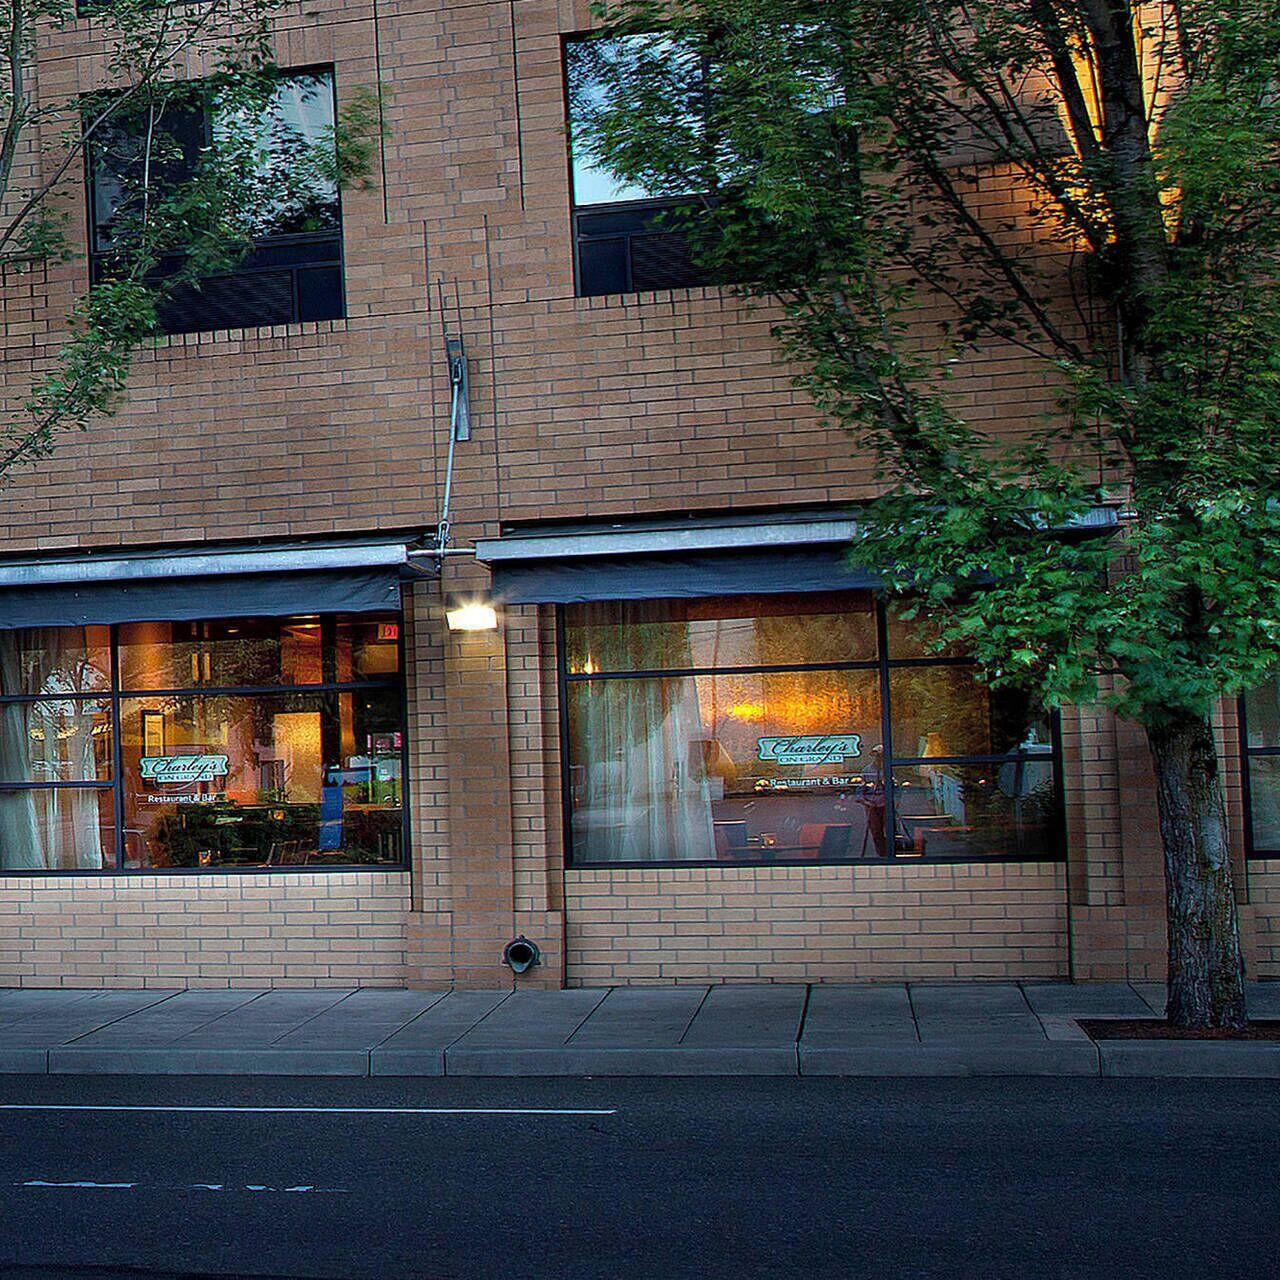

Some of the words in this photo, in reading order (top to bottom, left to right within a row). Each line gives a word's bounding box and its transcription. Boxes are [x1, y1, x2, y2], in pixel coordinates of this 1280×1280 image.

[771, 736, 848, 760] Charley's
[151, 755, 217, 780] Charley's
[822, 777, 830, 785] &
[832, 776, 849, 784] Bar
[193, 794, 200, 802] &
[201, 793, 217, 801] Bar
